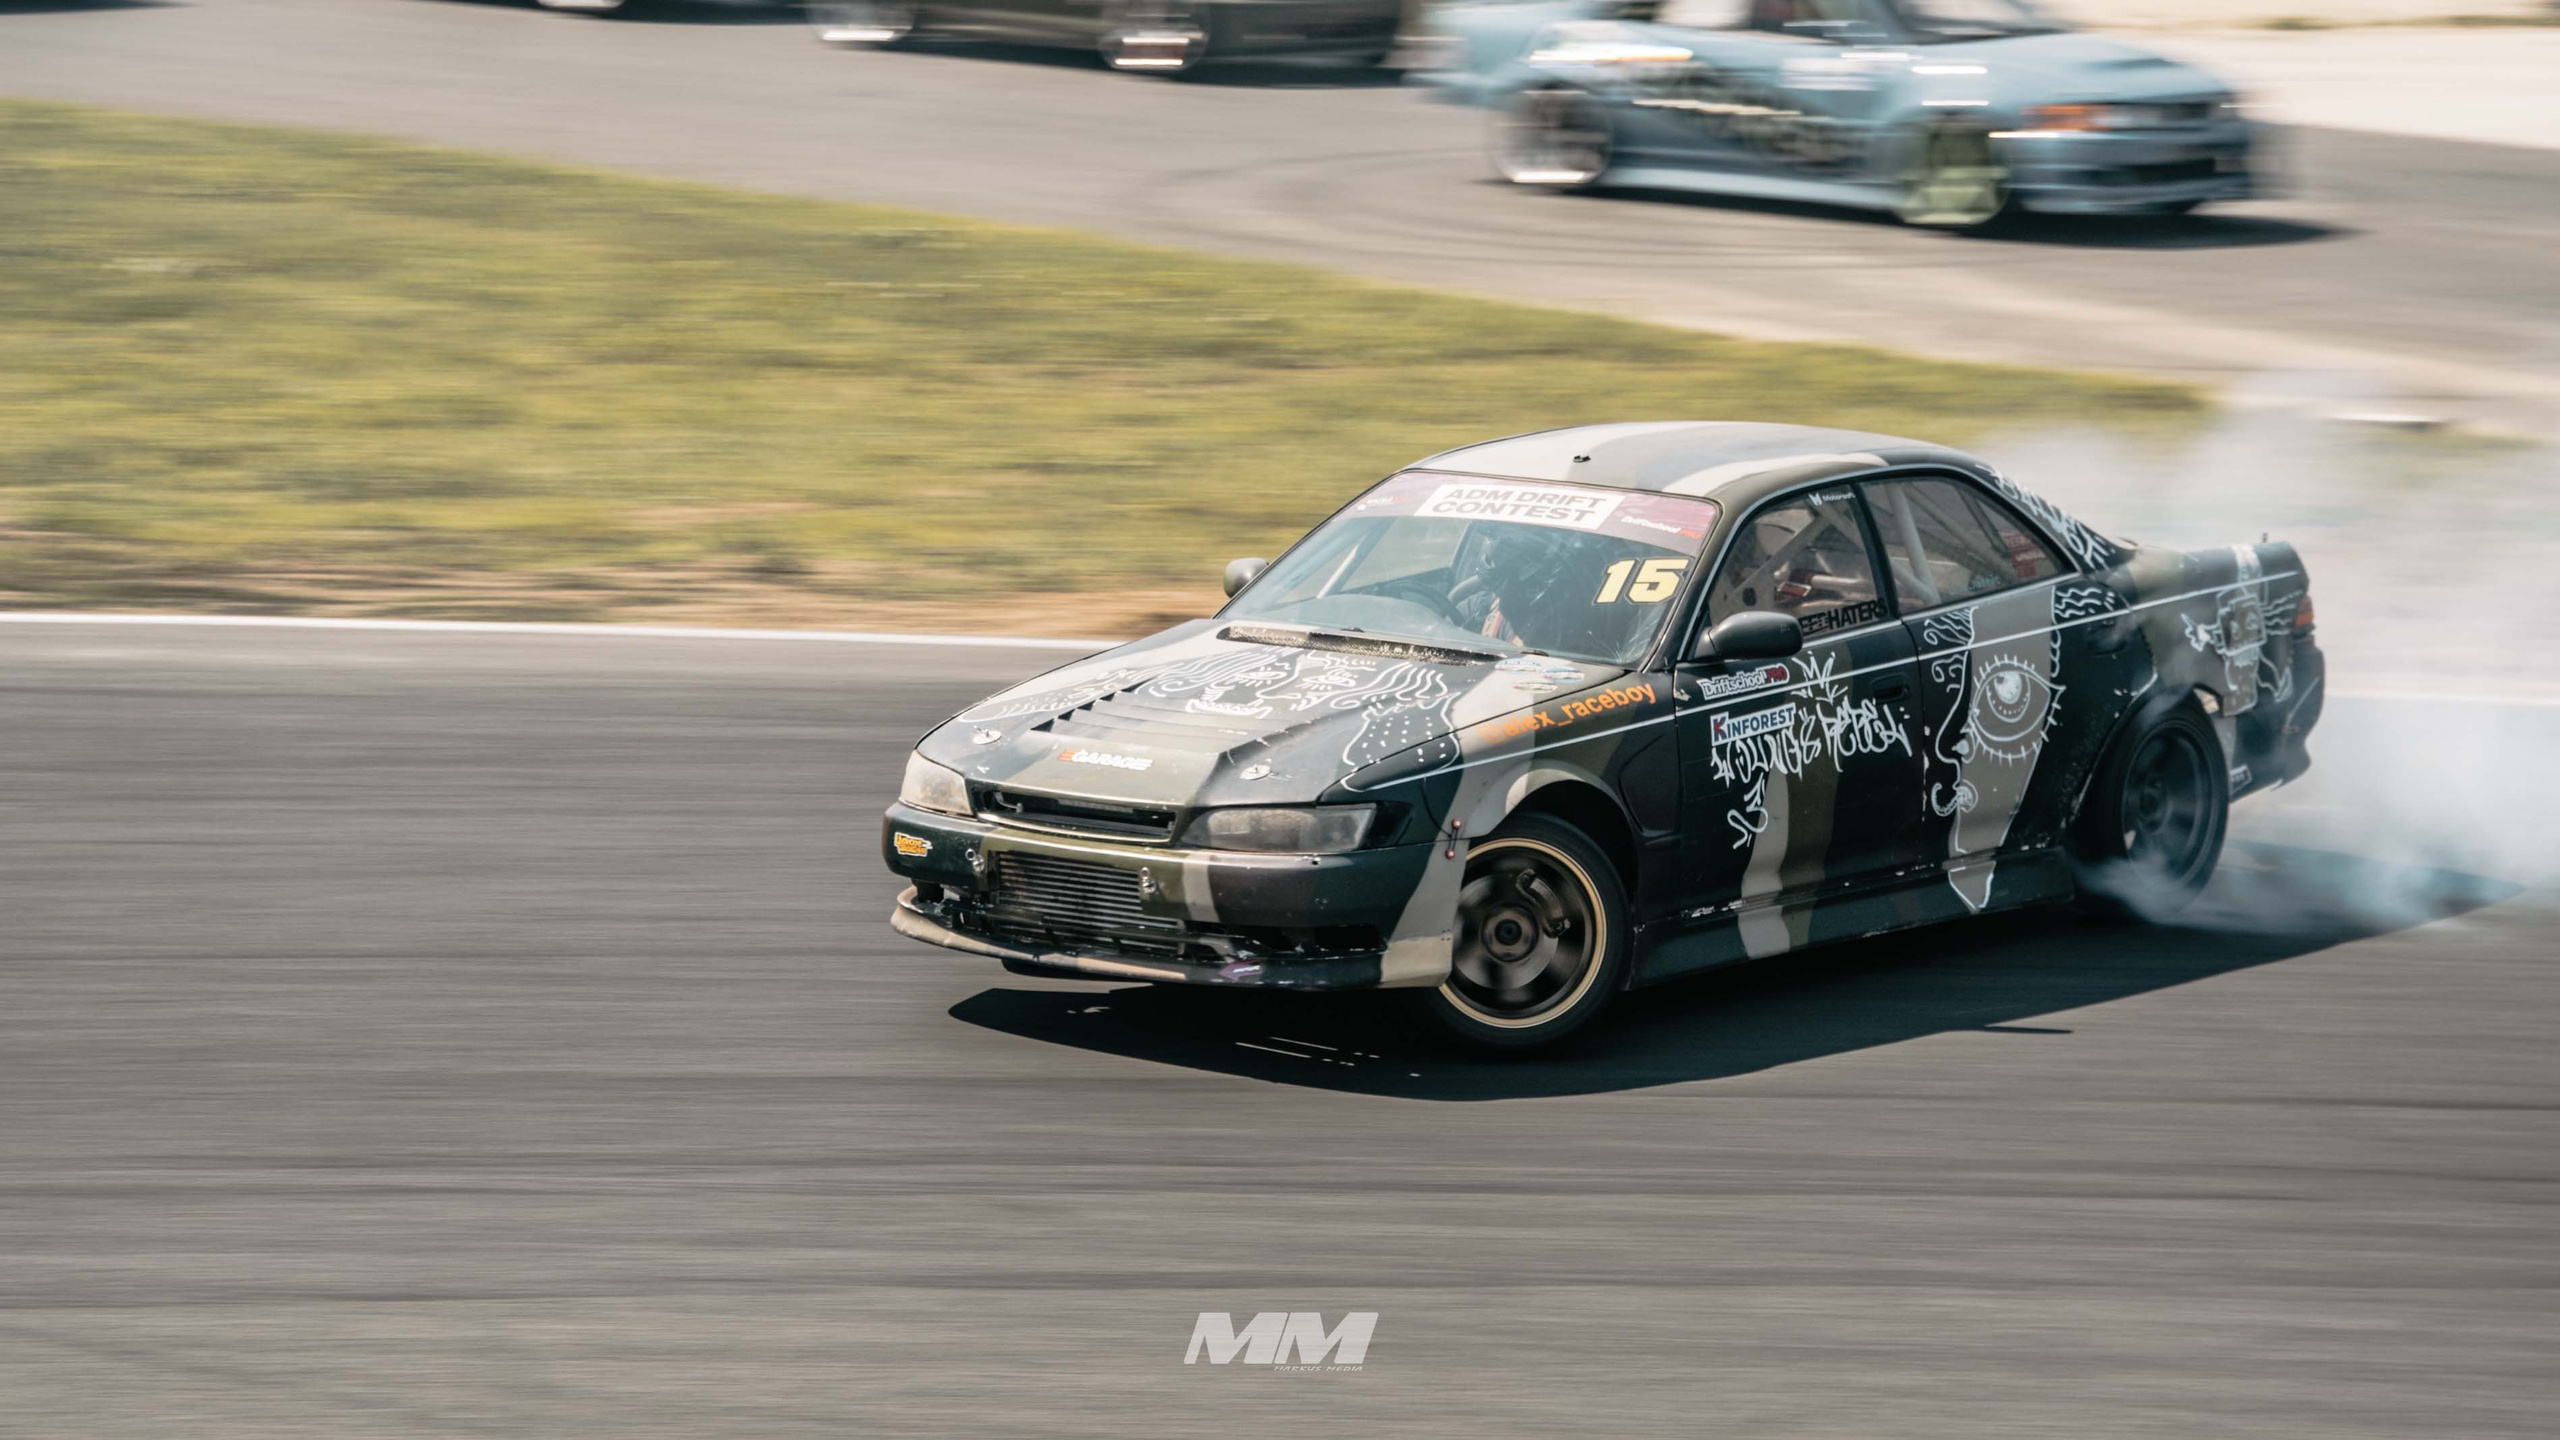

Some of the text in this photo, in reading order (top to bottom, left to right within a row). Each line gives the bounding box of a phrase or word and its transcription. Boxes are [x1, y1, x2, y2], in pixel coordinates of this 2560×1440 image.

[1432, 501, 1596, 522] CONTEST
[1445, 489, 1607, 508] ADM DRIFT
[1594, 558, 1690, 604] 15
[1475, 683, 1657, 745] @alex_raceboy
[1712, 706, 1795, 743] KINFOREST
